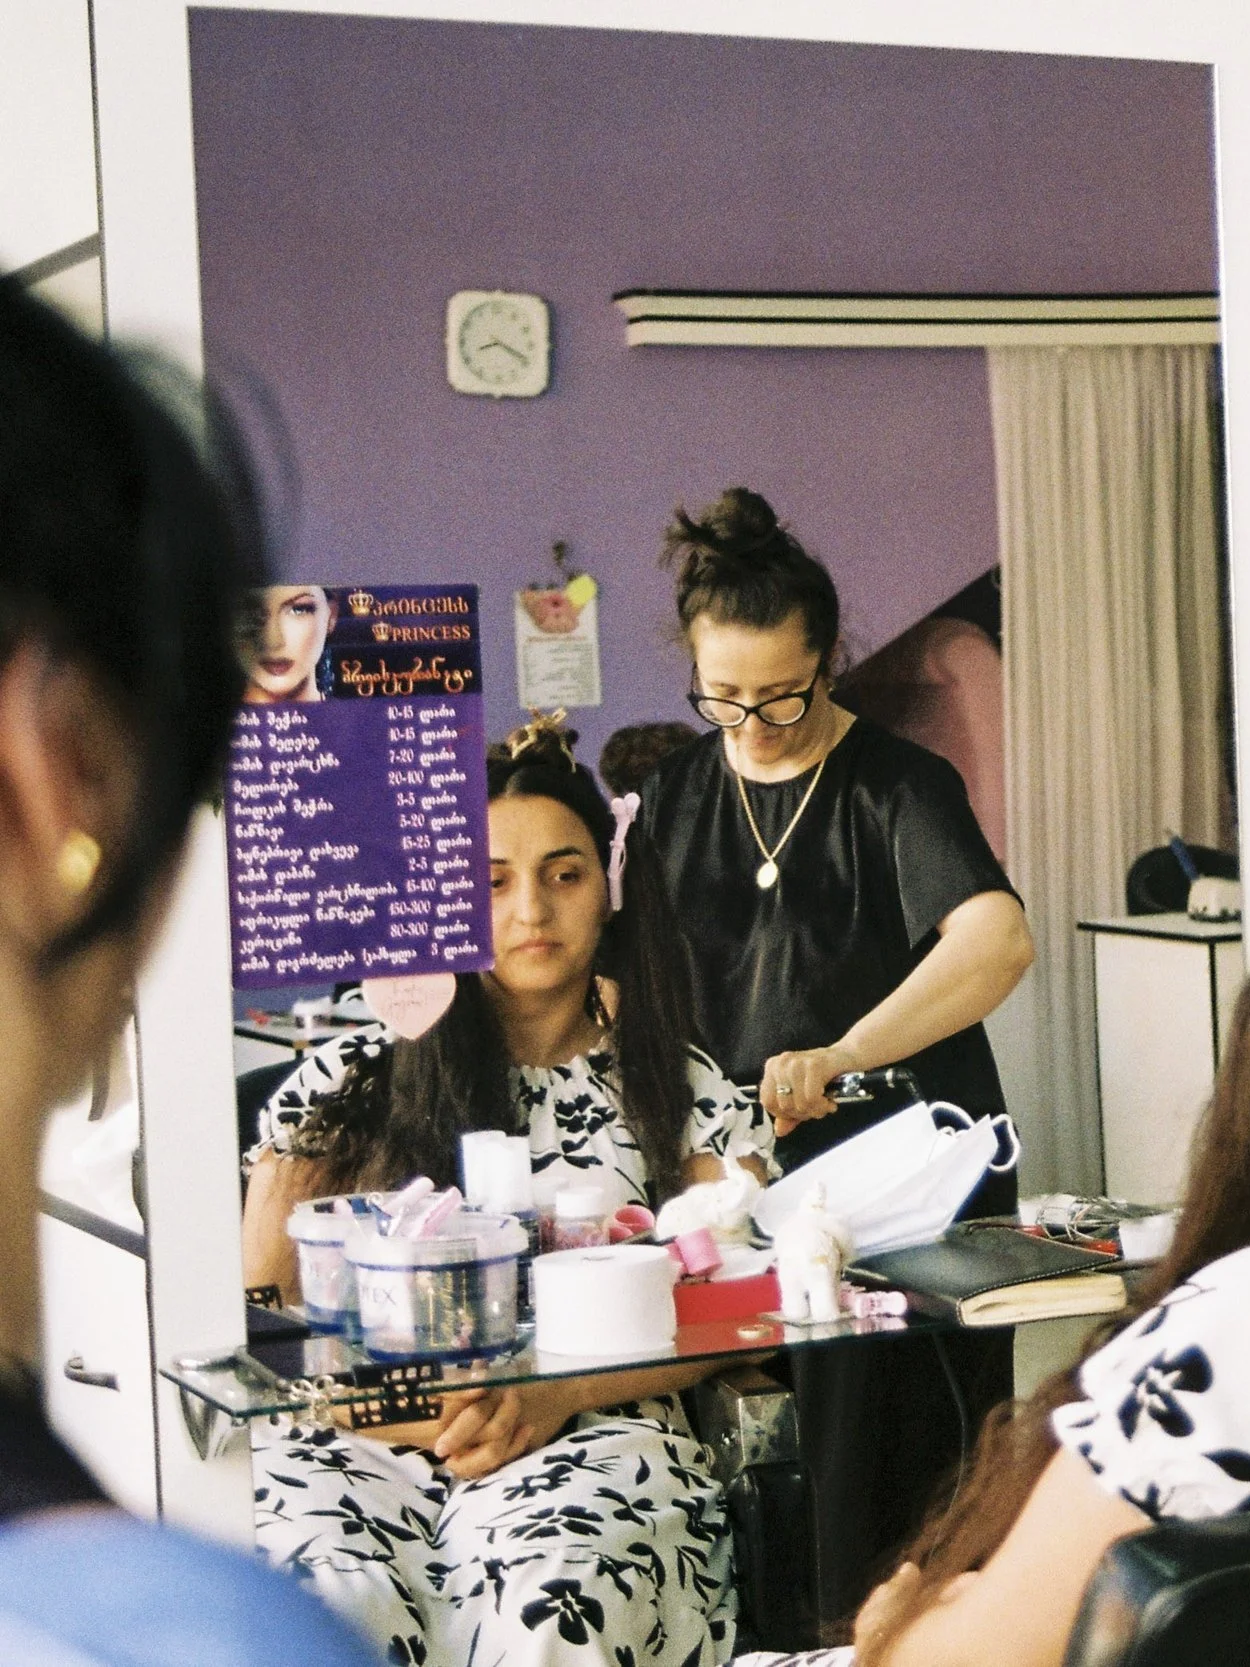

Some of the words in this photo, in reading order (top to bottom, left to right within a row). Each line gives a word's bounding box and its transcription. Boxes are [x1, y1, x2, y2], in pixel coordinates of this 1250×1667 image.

[393, 625, 471, 642] PRINCESS
[268, 711, 308, 731] შეჭრა
[388, 706, 414, 720] 10-15
[420, 703, 455, 724] ლარი
[268, 733, 320, 753] შეღებვა
[389, 727, 415, 741] 10-15
[421, 725, 458, 746] ლარი
[389, 750, 414, 763] 7-20
[420, 747, 456, 767] ლარი
[388, 770, 424, 786] 20-100
[430, 768, 466, 788] ლარი
[293, 798, 334, 818] შეჭრა
[397, 792, 415, 806] 3-5
[421, 790, 457, 810] ლარი
[236, 823, 284, 841] ნაწნავი
[400, 814, 425, 828] 5-20
[431, 811, 466, 831] ლარი
[237, 845, 303, 864] ბუნებრივი
[310, 841, 359, 861] დახვევა
[402, 835, 431, 849] 15-25
[436, 833, 472, 852] ლარი
[238, 867, 267, 882] თმის
[275, 864, 316, 885] დაბანა
[409, 857, 427, 871] 2-5
[434, 854, 469, 874] ლარი
[238, 888, 310, 909] საქორწილო
[406, 878, 436, 893] 15-100
[441, 876, 474, 895] ლარი
[316, 904, 376, 925] ნაწნავები
[390, 900, 431, 916] 150-300
[436, 897, 473, 917] ლარი
[390, 922, 428, 938] 80-300
[434, 919, 470, 939] ლარი
[242, 956, 269, 970] თმის
[444, 940, 478, 960] ლარი
